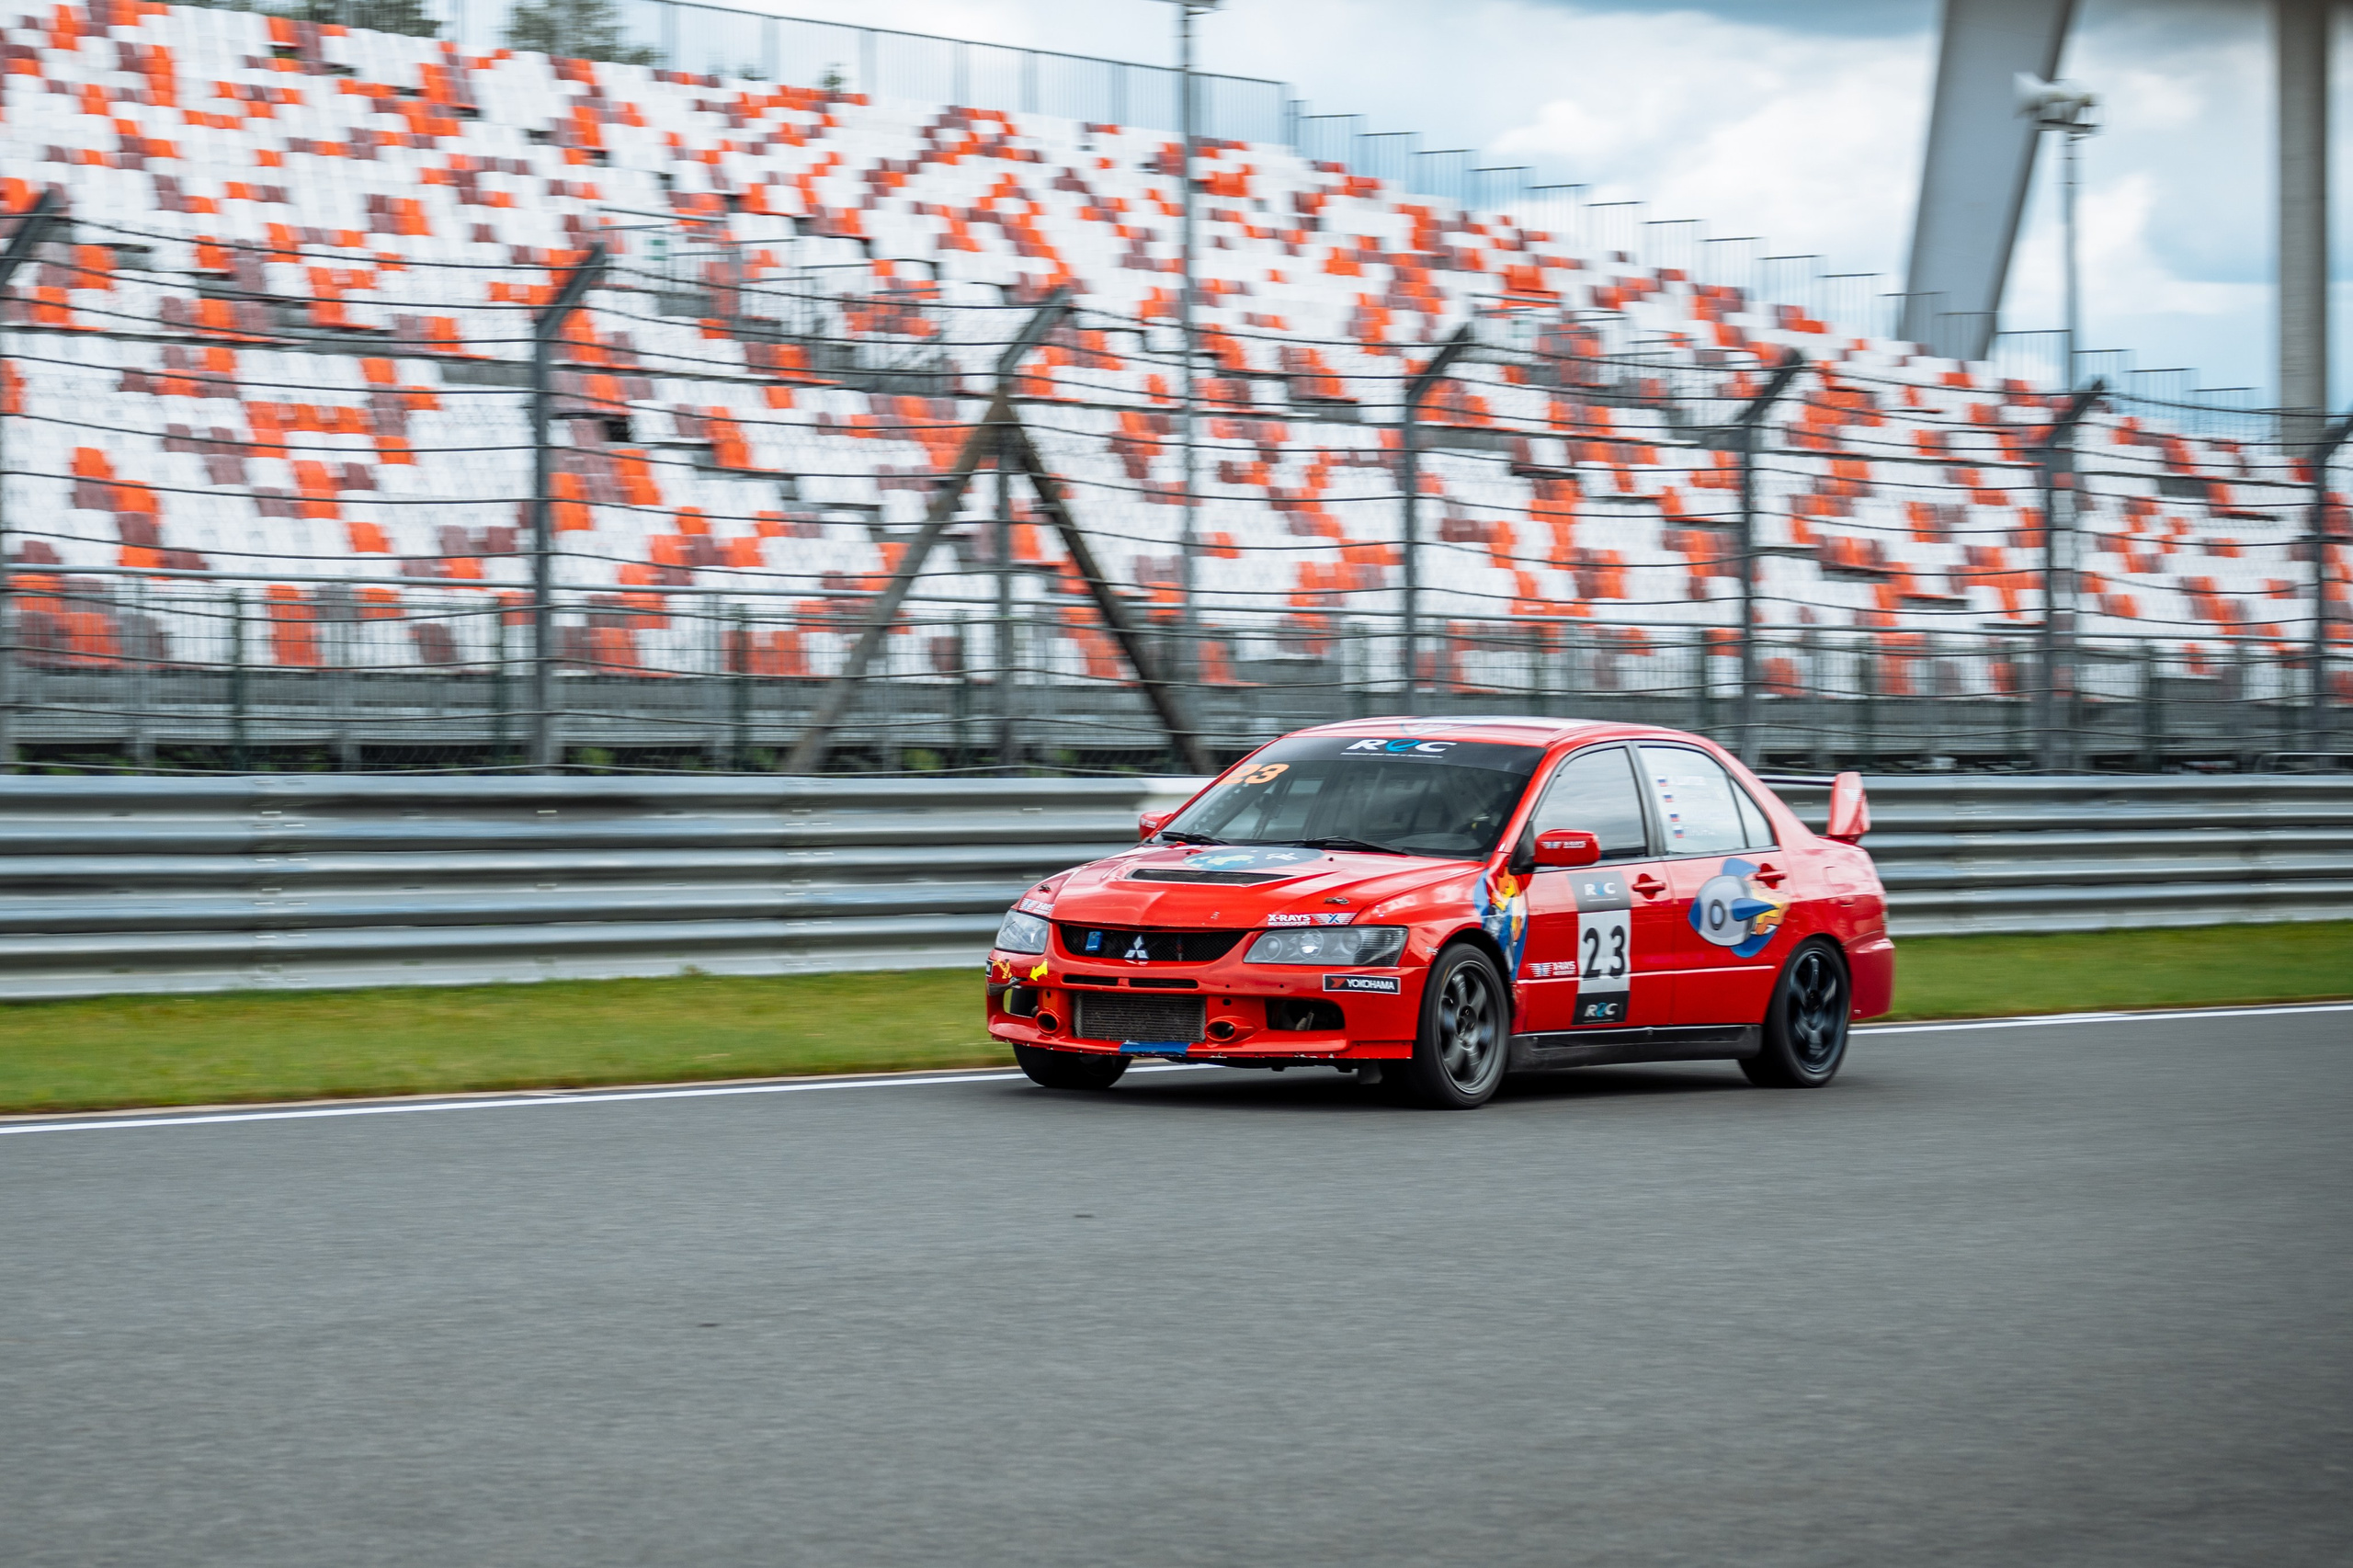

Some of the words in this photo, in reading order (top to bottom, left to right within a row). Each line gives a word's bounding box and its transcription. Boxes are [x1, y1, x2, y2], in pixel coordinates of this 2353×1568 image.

[1218, 763, 1290, 785] 23
[1267, 914, 1311, 922] X-RAYS
[1582, 925, 1626, 981] 23
[1347, 978, 1395, 990] YOKOHAMA
